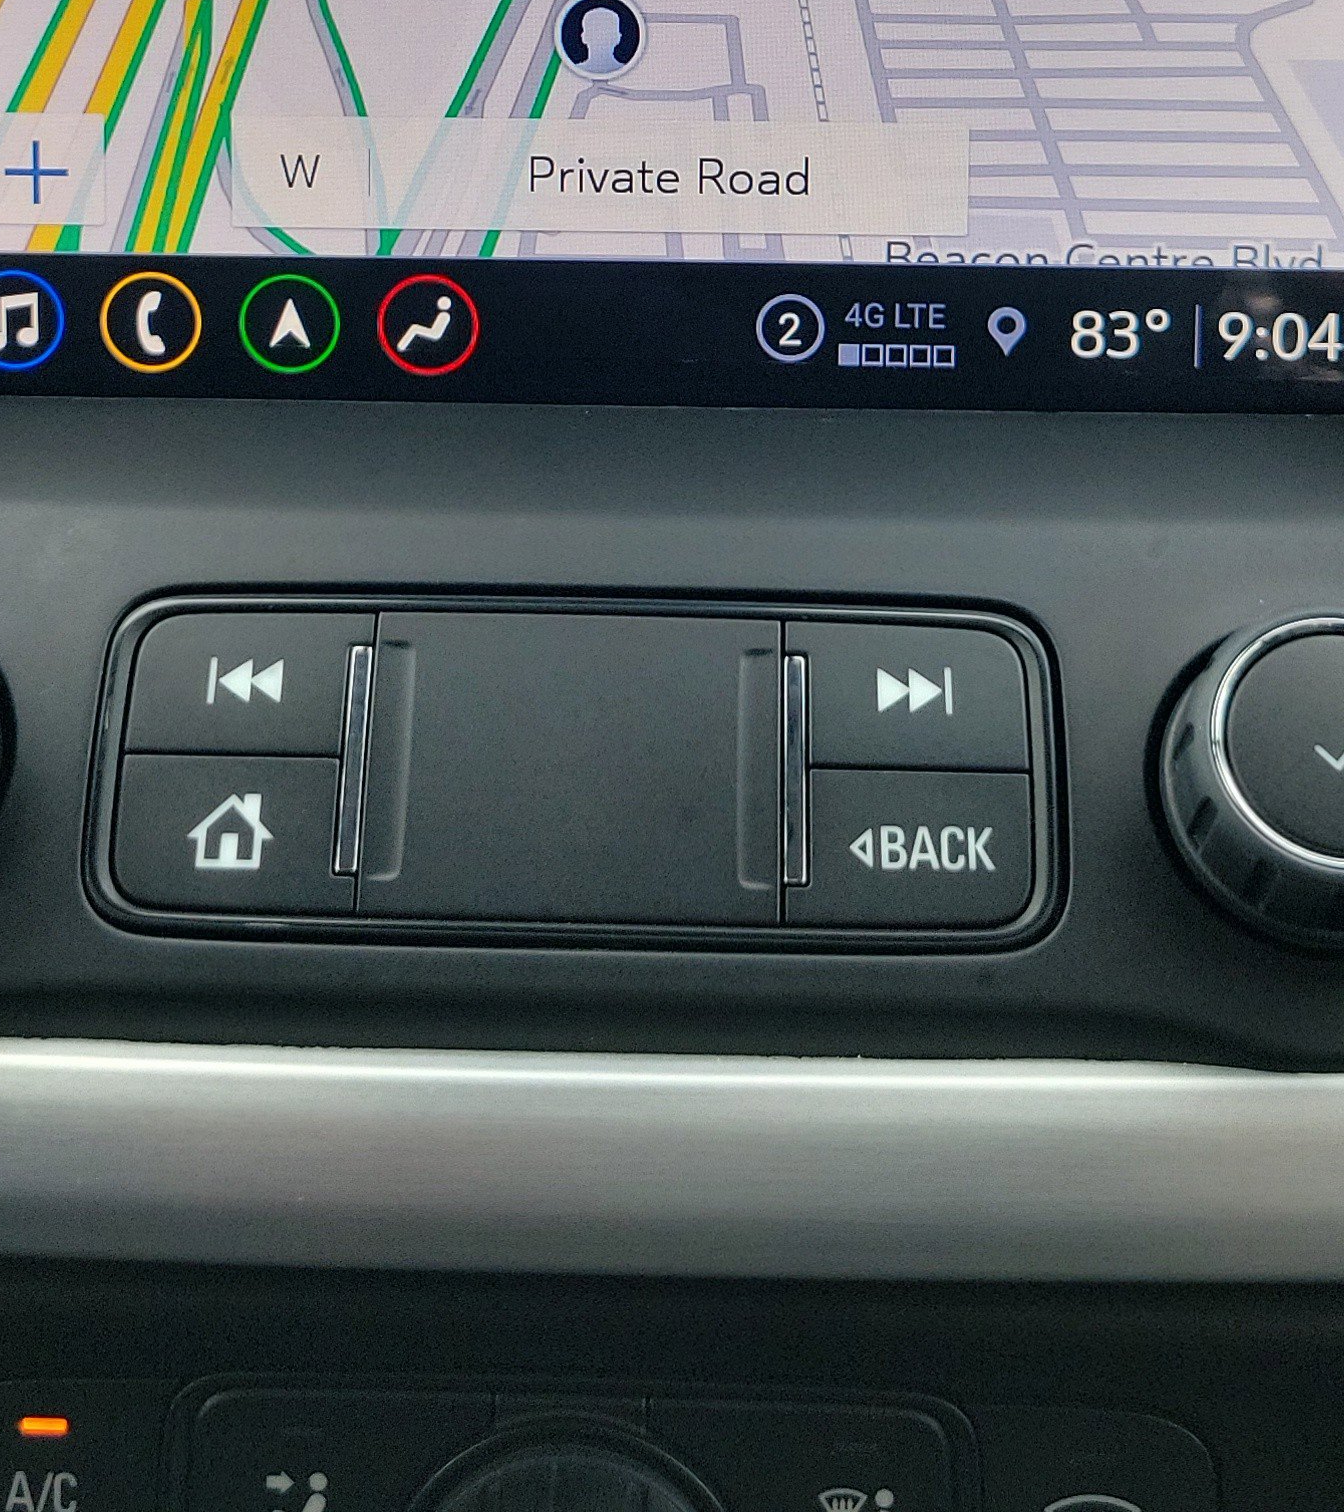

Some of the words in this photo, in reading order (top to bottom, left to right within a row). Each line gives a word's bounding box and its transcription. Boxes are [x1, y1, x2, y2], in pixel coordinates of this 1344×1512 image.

[280, 153, 320, 189] W
[528, 156, 680, 196] Private
[698, 156, 812, 196] Road
[778, 313, 802, 348] 2
[843, 302, 885, 329] 4G
[894, 302, 947, 330] LTE
[1070, 308, 1172, 360] 83°
[879, 826, 996, 872] BACK
[5, 1470, 78, 1512] A/C
